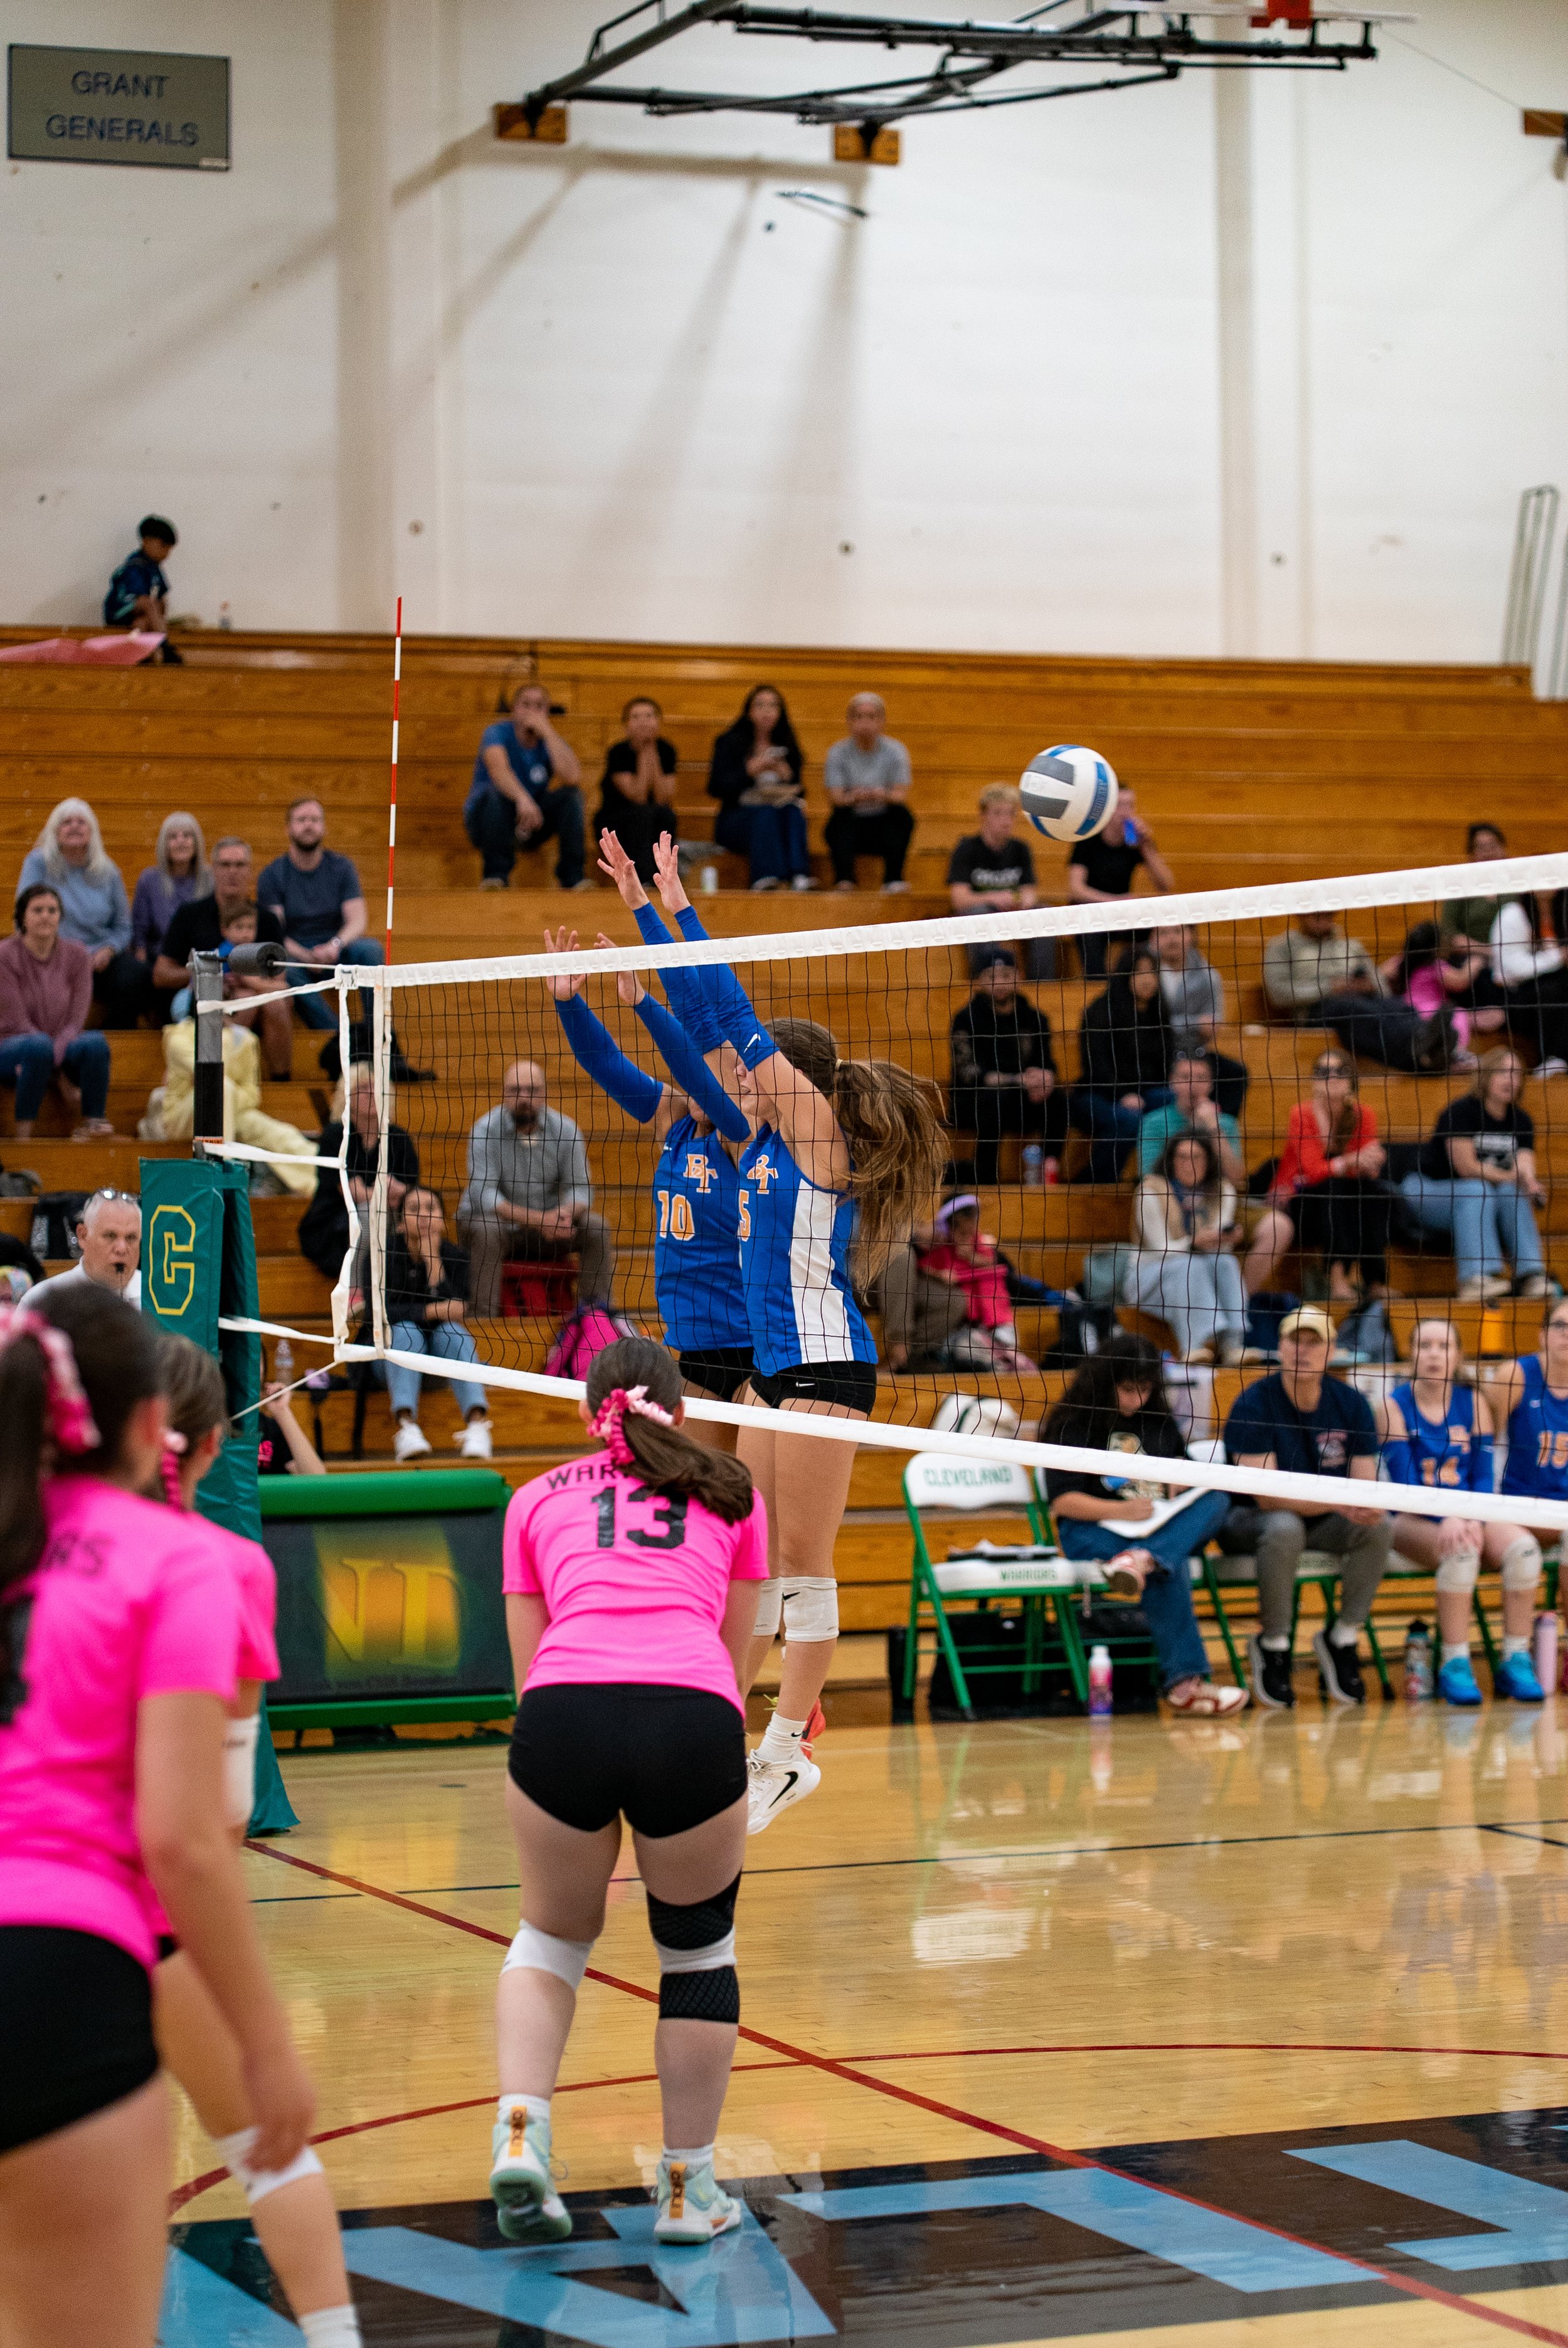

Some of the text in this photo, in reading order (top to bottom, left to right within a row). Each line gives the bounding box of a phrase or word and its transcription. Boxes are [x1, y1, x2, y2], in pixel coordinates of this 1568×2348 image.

[71, 70, 170, 98] GRANT
[45, 114, 199, 147] GENERALS
[657, 1190, 696, 1241] 10
[924, 1467, 1012, 1486] CLEVELAND
[590, 1485, 689, 1549] 13
